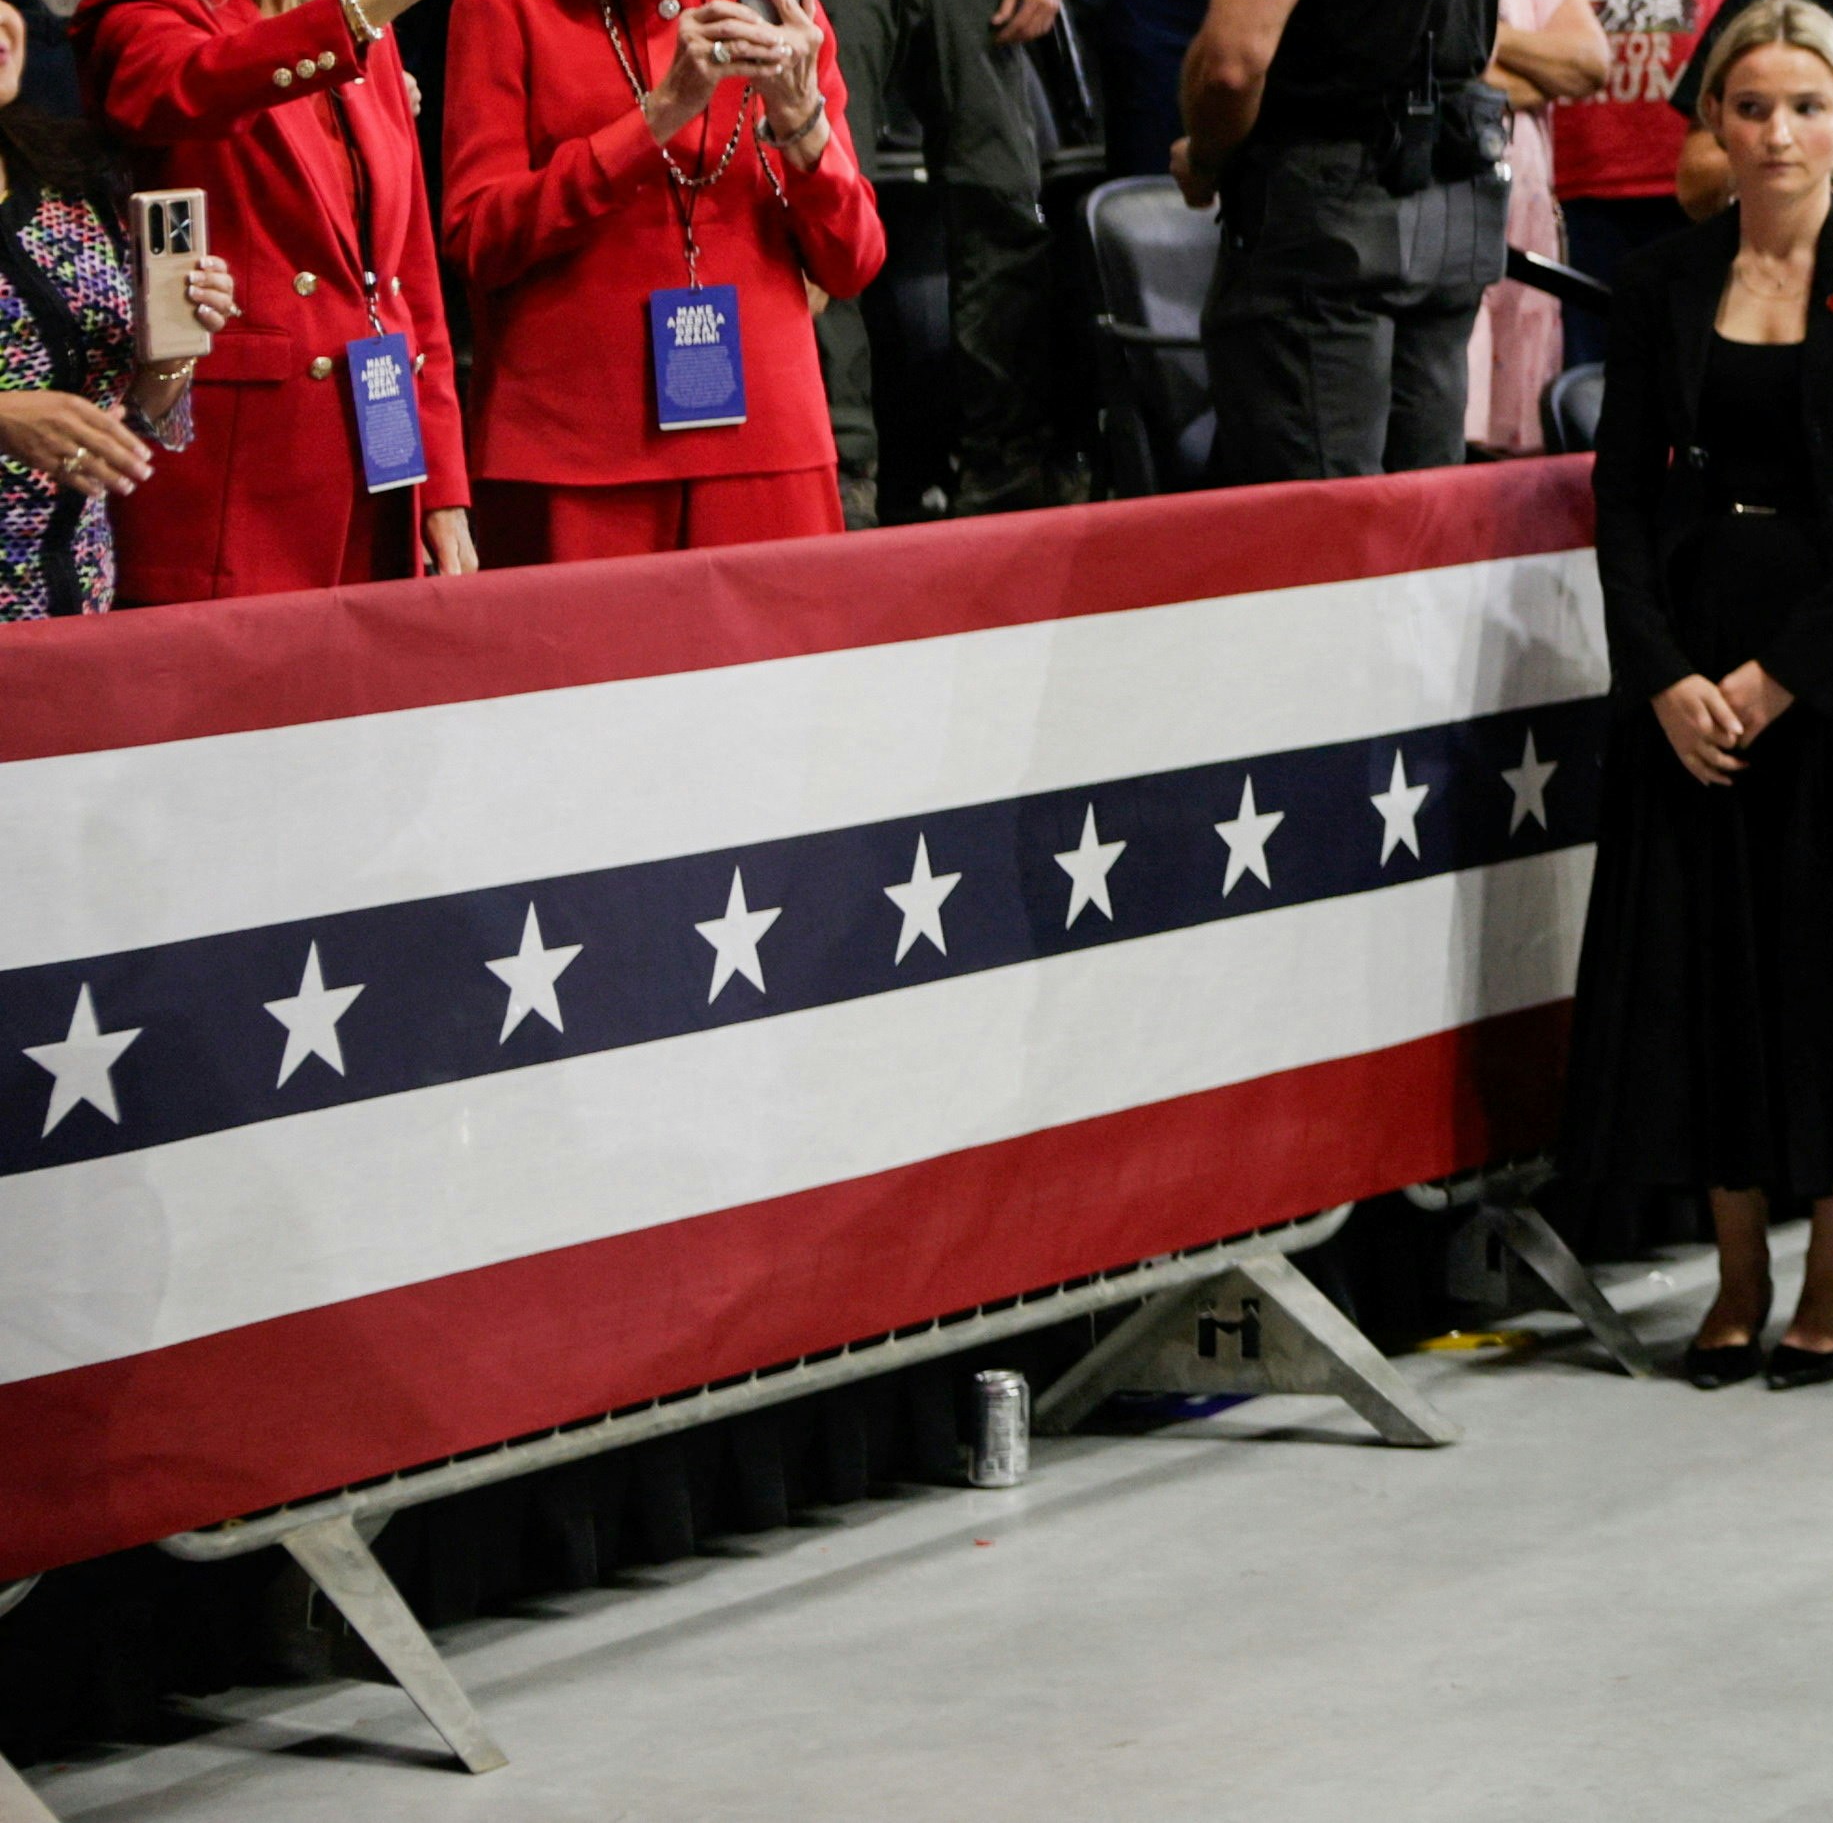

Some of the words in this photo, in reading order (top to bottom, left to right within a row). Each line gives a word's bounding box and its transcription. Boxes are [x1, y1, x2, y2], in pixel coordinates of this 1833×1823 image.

[676, 304, 714, 318] MAKE
[667, 312, 725, 329] AMERICA
[675, 322, 717, 337] GREAT
[675, 331, 720, 347] AGAIN!
[366, 355, 392, 368] MAKE
[361, 363, 402, 383] AMERICA
[367, 373, 397, 390] GREAT
[368, 384, 400, 402] AGAIN!
